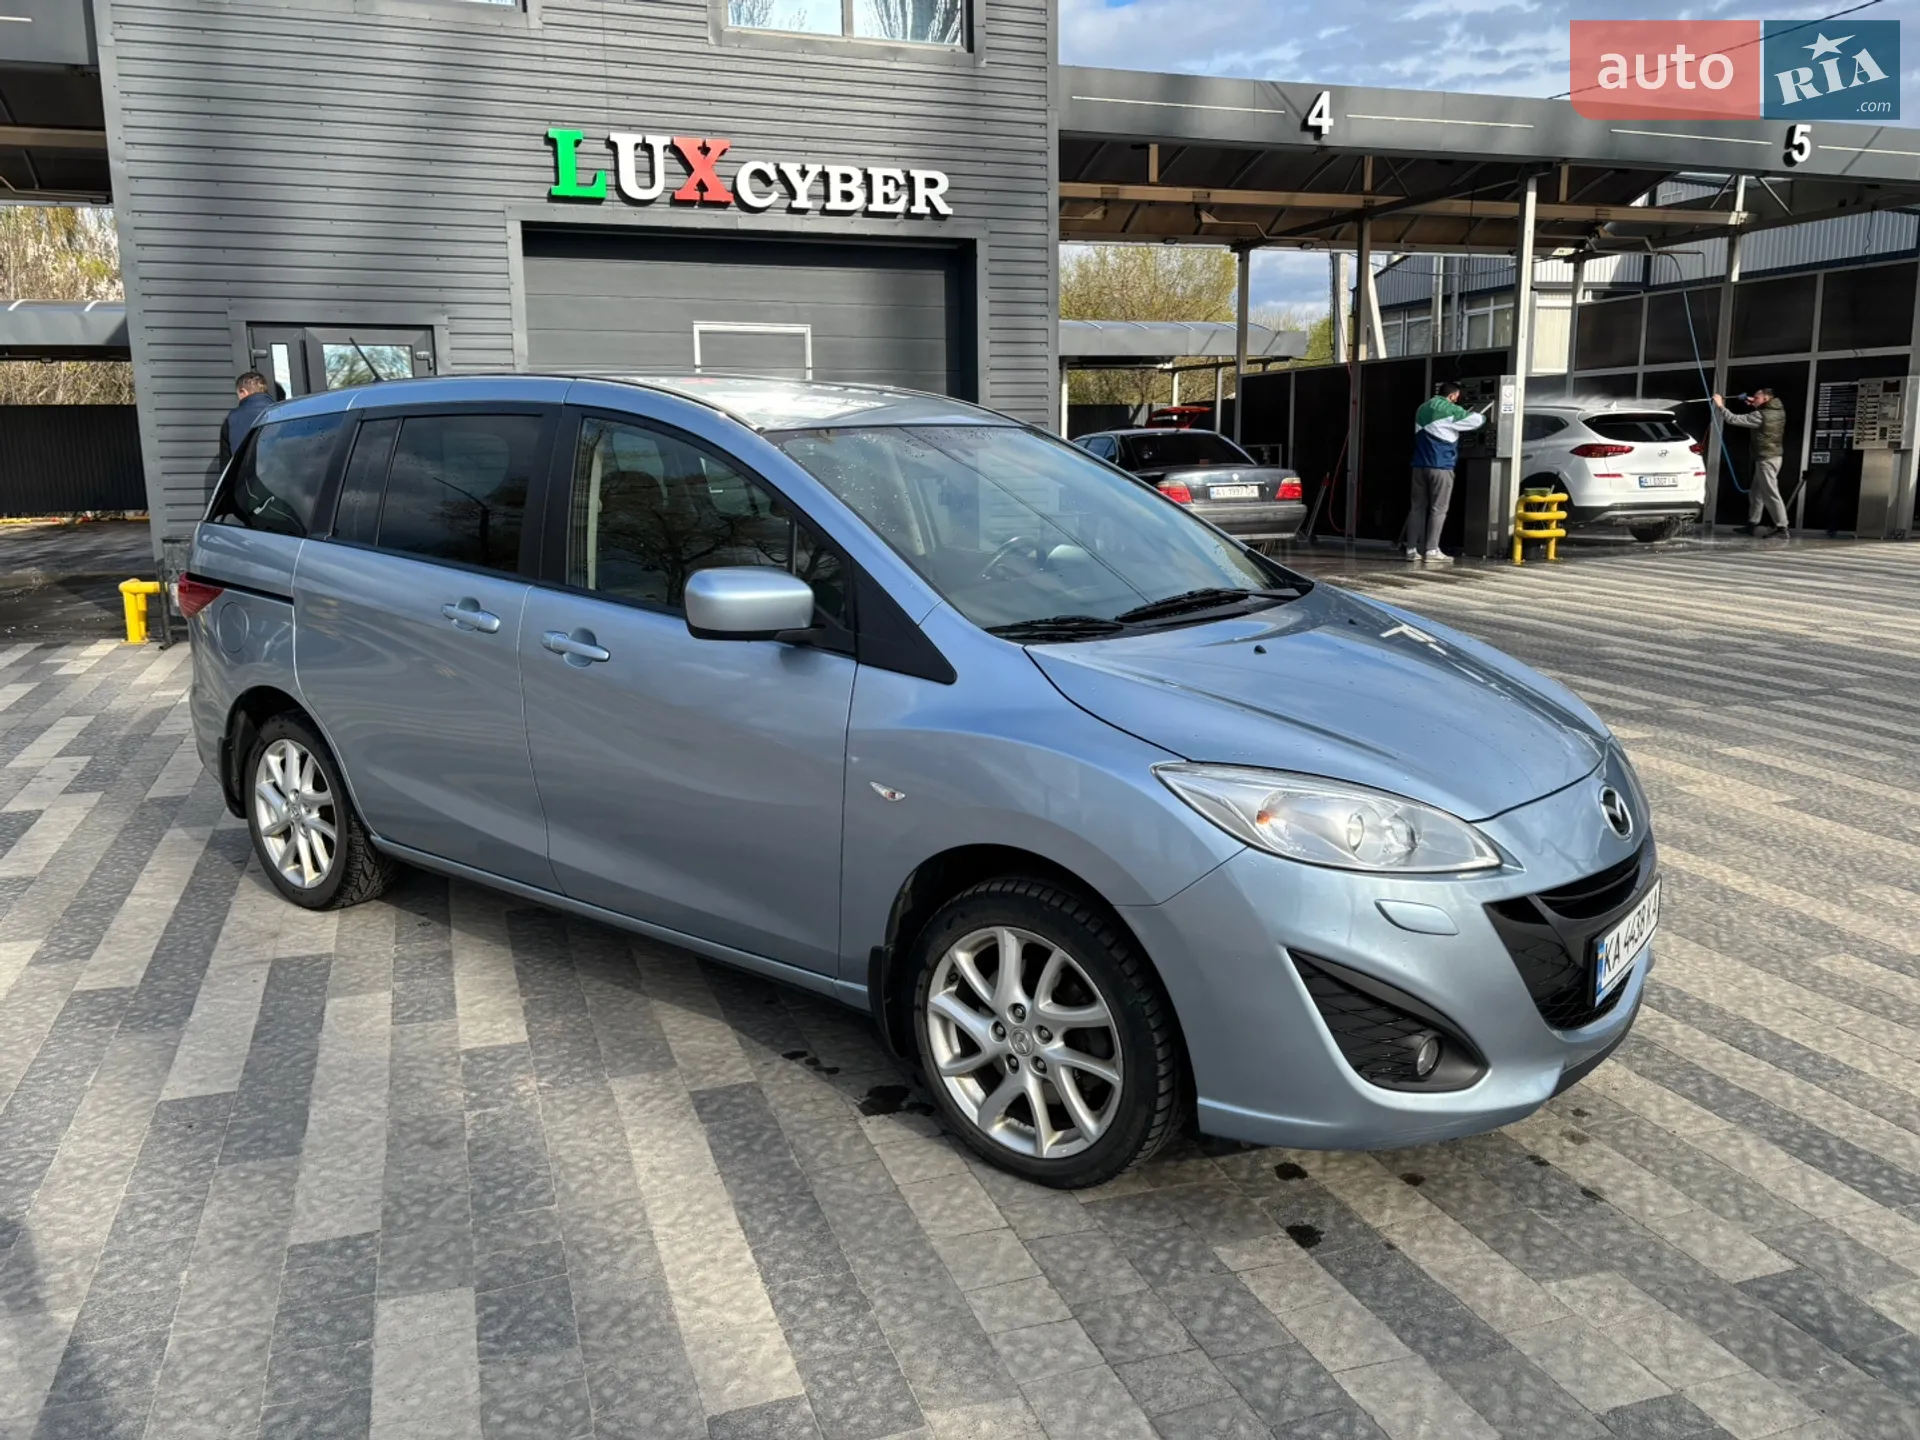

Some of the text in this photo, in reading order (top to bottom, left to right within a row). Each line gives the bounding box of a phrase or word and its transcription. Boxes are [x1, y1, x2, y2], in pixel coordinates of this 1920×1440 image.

[1308, 91, 1334, 134] 4
[1792, 124, 1811, 162] 5
[1603, 931, 1620, 977] KA
